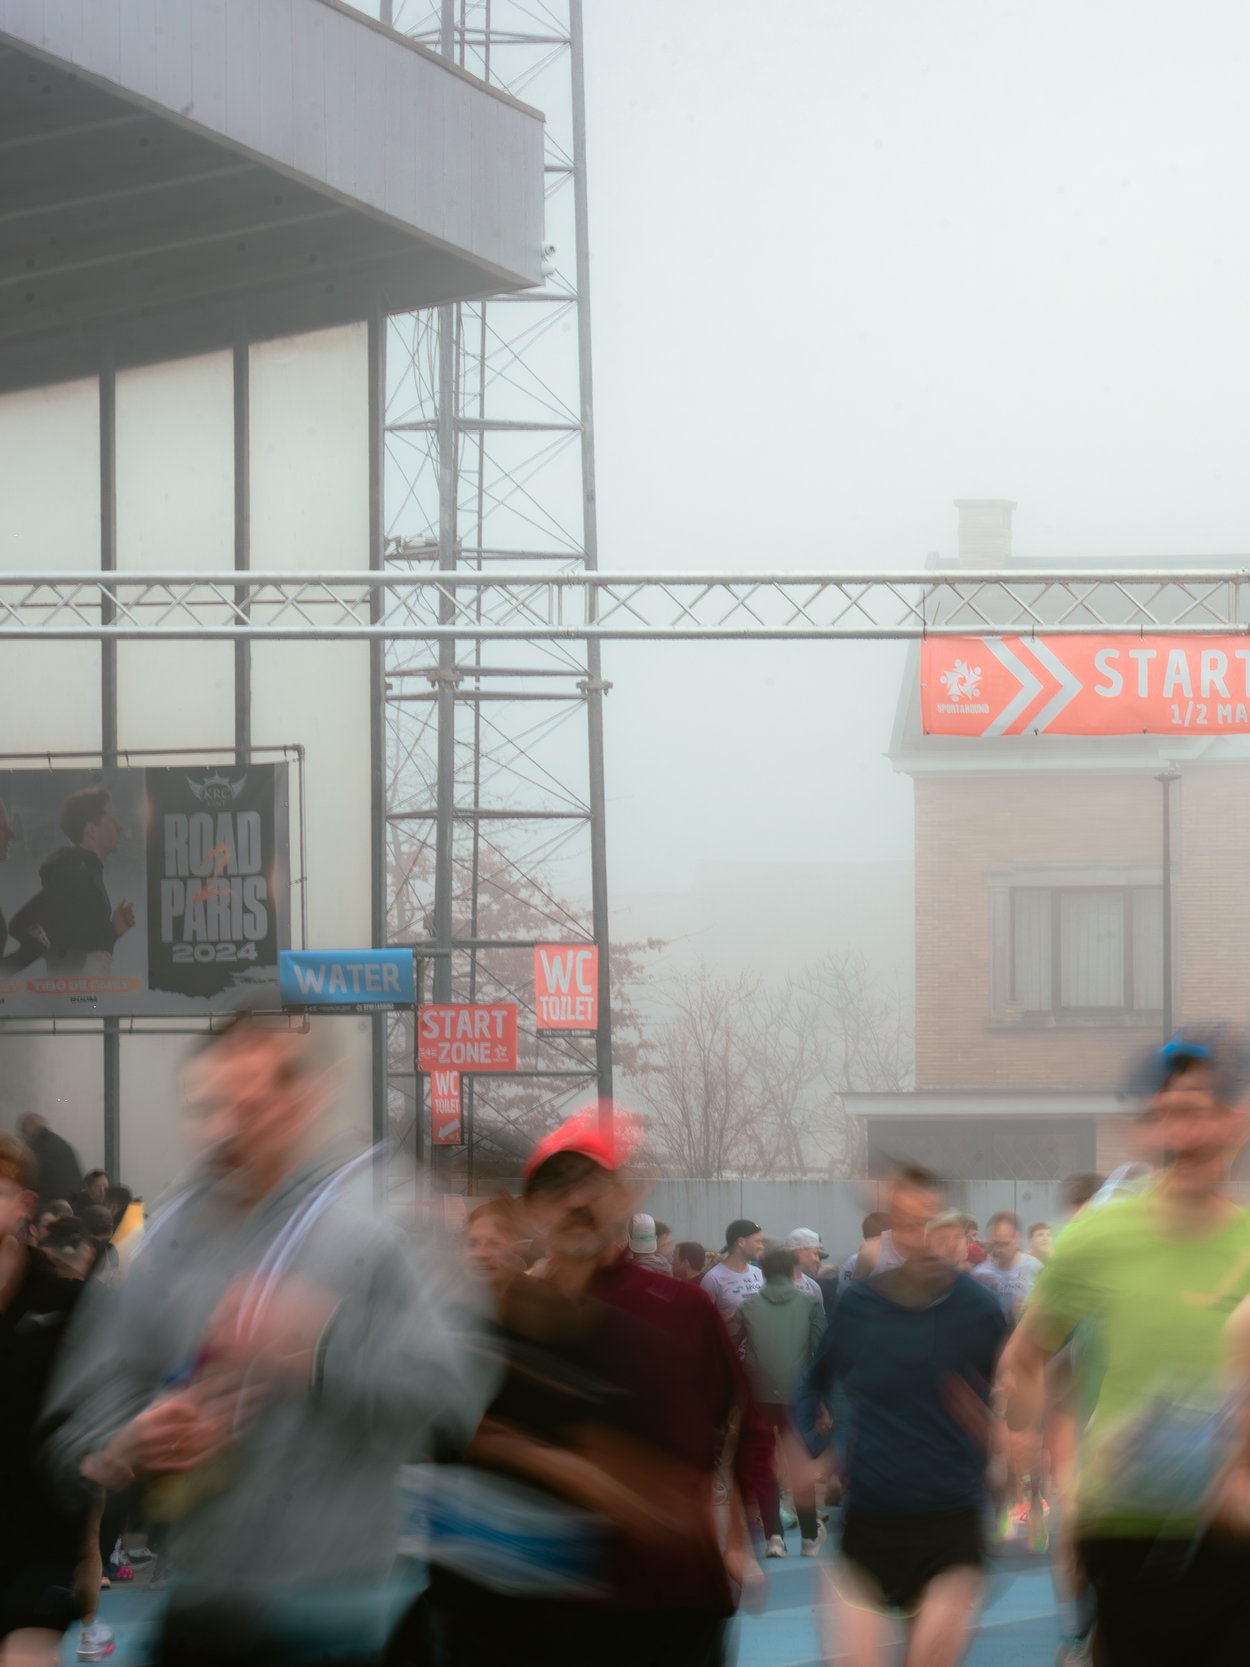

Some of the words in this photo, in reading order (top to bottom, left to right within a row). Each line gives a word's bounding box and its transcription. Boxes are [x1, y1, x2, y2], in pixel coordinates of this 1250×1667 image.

[1171, 702, 1208, 727] 1/2
[164, 811, 261, 877] ROAD
[160, 874, 268, 943] PARIS
[172, 941, 258, 963] 2024
[293, 963, 401, 994] WATER
[540, 950, 593, 995] WC
[539, 996, 593, 1022] TOILET
[422, 1009, 508, 1040] START
[437, 1042, 492, 1065] ZONE
[434, 1070, 459, 1096] WC
[434, 1099, 460, 1114] TOILET
